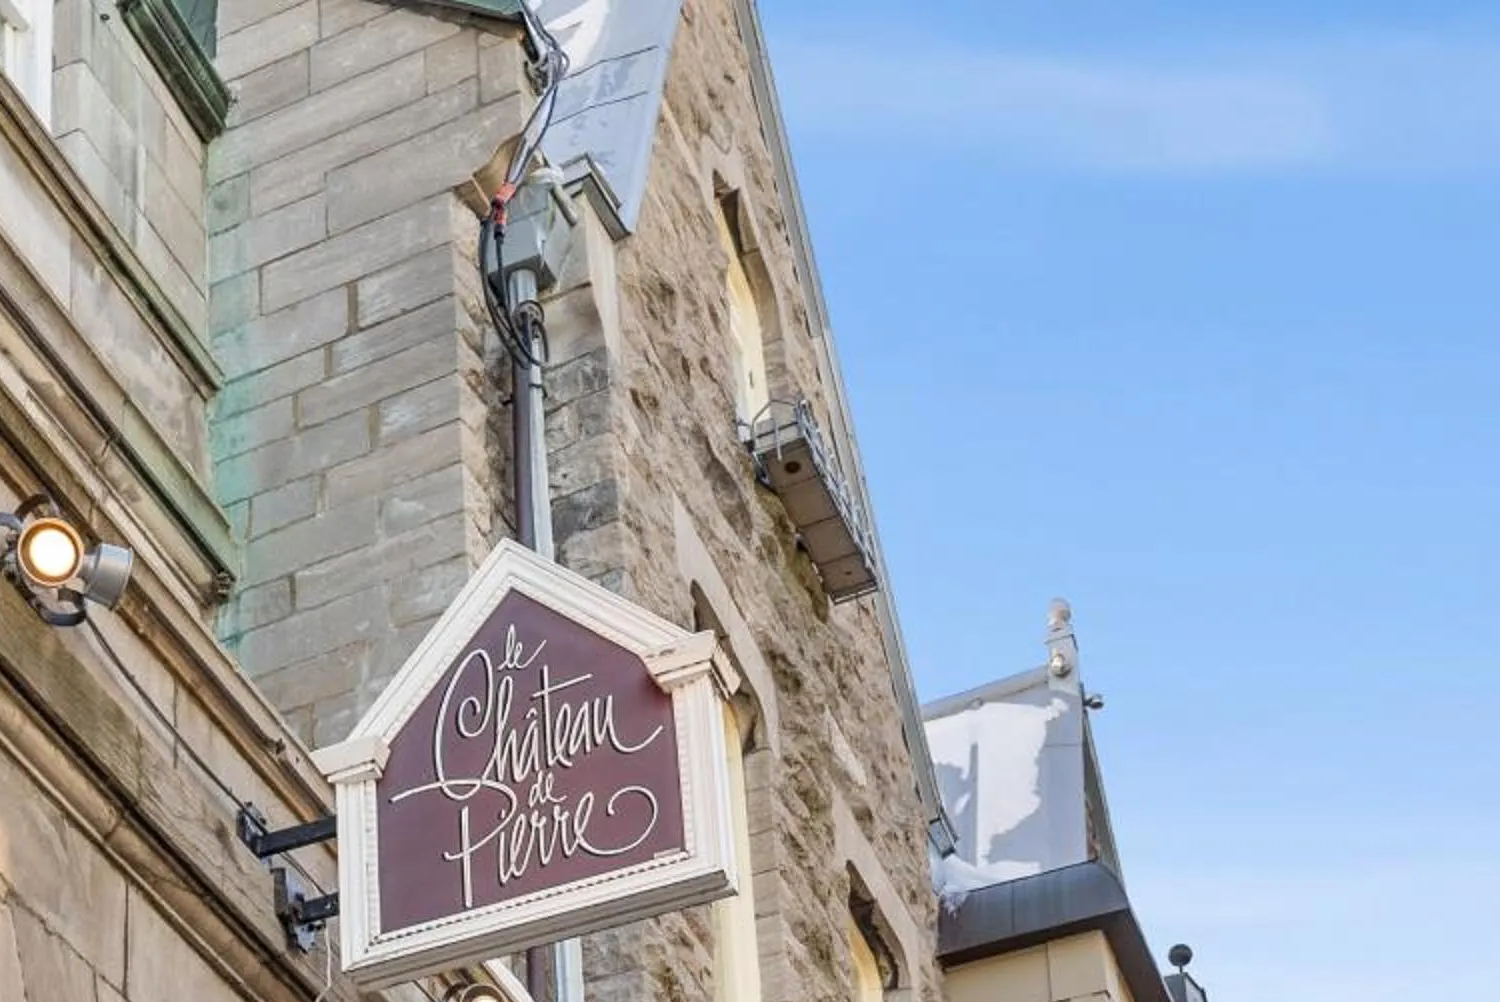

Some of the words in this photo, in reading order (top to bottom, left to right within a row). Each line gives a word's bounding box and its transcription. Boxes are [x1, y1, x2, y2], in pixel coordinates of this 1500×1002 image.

[498, 623, 547, 671] le
[434, 648, 663, 800] Château
[528, 770, 567, 808] de
[389, 780, 658, 908] Pierre
